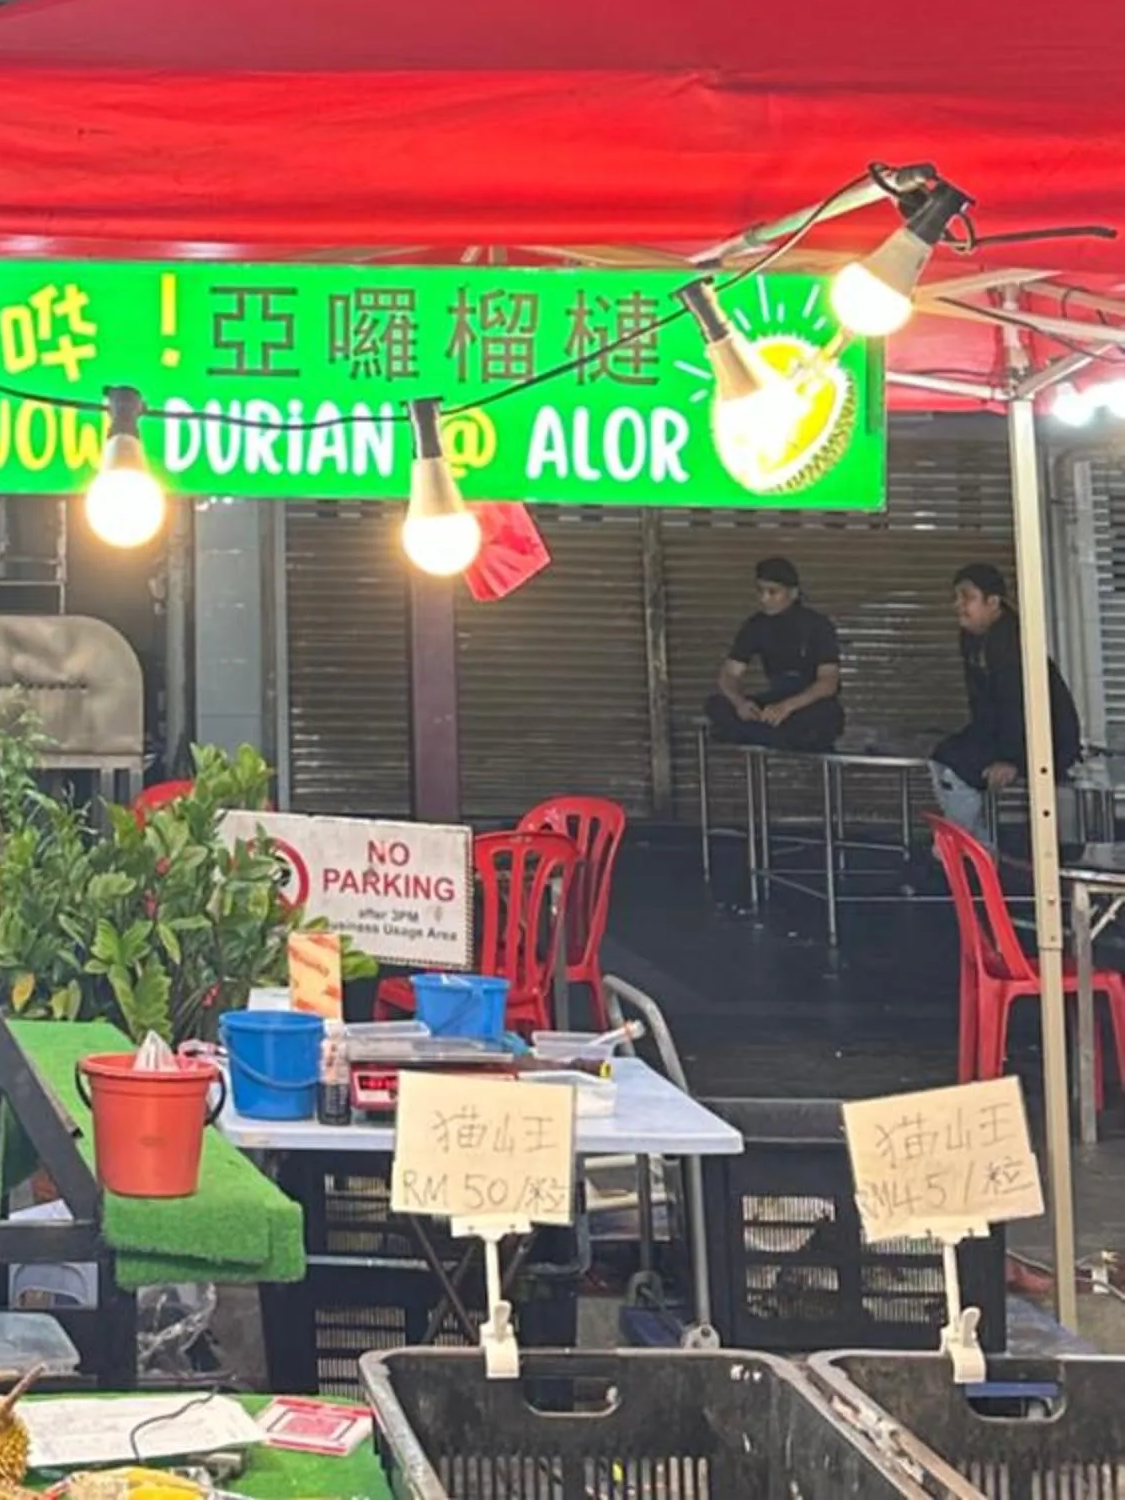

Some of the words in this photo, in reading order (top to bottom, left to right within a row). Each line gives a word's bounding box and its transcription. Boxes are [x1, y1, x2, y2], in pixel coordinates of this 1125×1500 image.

[206, 281, 662, 387] 亞囉榴槤
[439, 404, 497, 479] @
[527, 405, 690, 484] ALOR
[367, 840, 411, 867] NO
[323, 868, 456, 902] PARKING
[330, 920, 380, 936] usiness
[383, 923, 424, 941] Usage
[427, 927, 457, 942] Area
[358, 908, 388, 922] after
[431, 1106, 558, 1155] 猫山王
[876, 1102, 1014, 1169] 猫山王
[403, 1170, 449, 1209] RM
